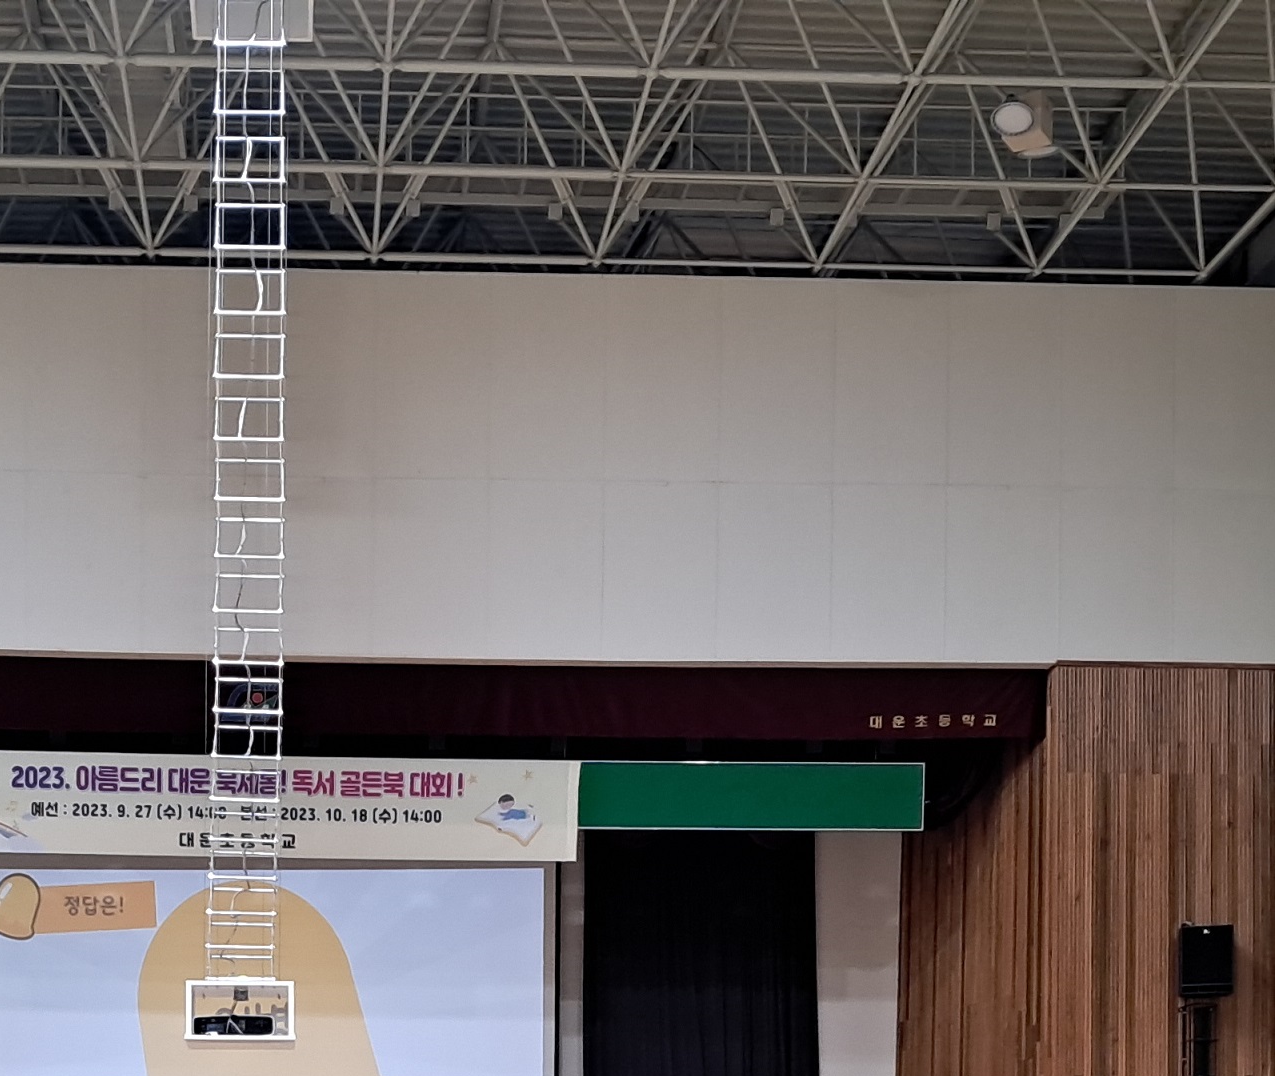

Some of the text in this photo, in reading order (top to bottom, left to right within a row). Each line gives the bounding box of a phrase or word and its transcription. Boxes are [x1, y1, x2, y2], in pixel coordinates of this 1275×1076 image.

[11, 765, 70, 789] 2023.
[76, 765, 162, 793] 아름드리
[168, 768, 211, 794] 대운
[292, 769, 335, 796] 독서
[339, 771, 404, 797] 골든북
[72, 803, 113, 818] 2023.
[117, 804, 130, 818] 9.
[135, 804, 152, 819] 27
[157, 803, 182, 821] (수)
[281, 807, 320, 821] 2023.
[325, 808, 346, 822] 10.
[351, 808, 368, 823] 18
[372, 807, 398, 825] (수)
[402, 809, 442, 824] 14:00
[63, 895, 124, 916] 정답은!
